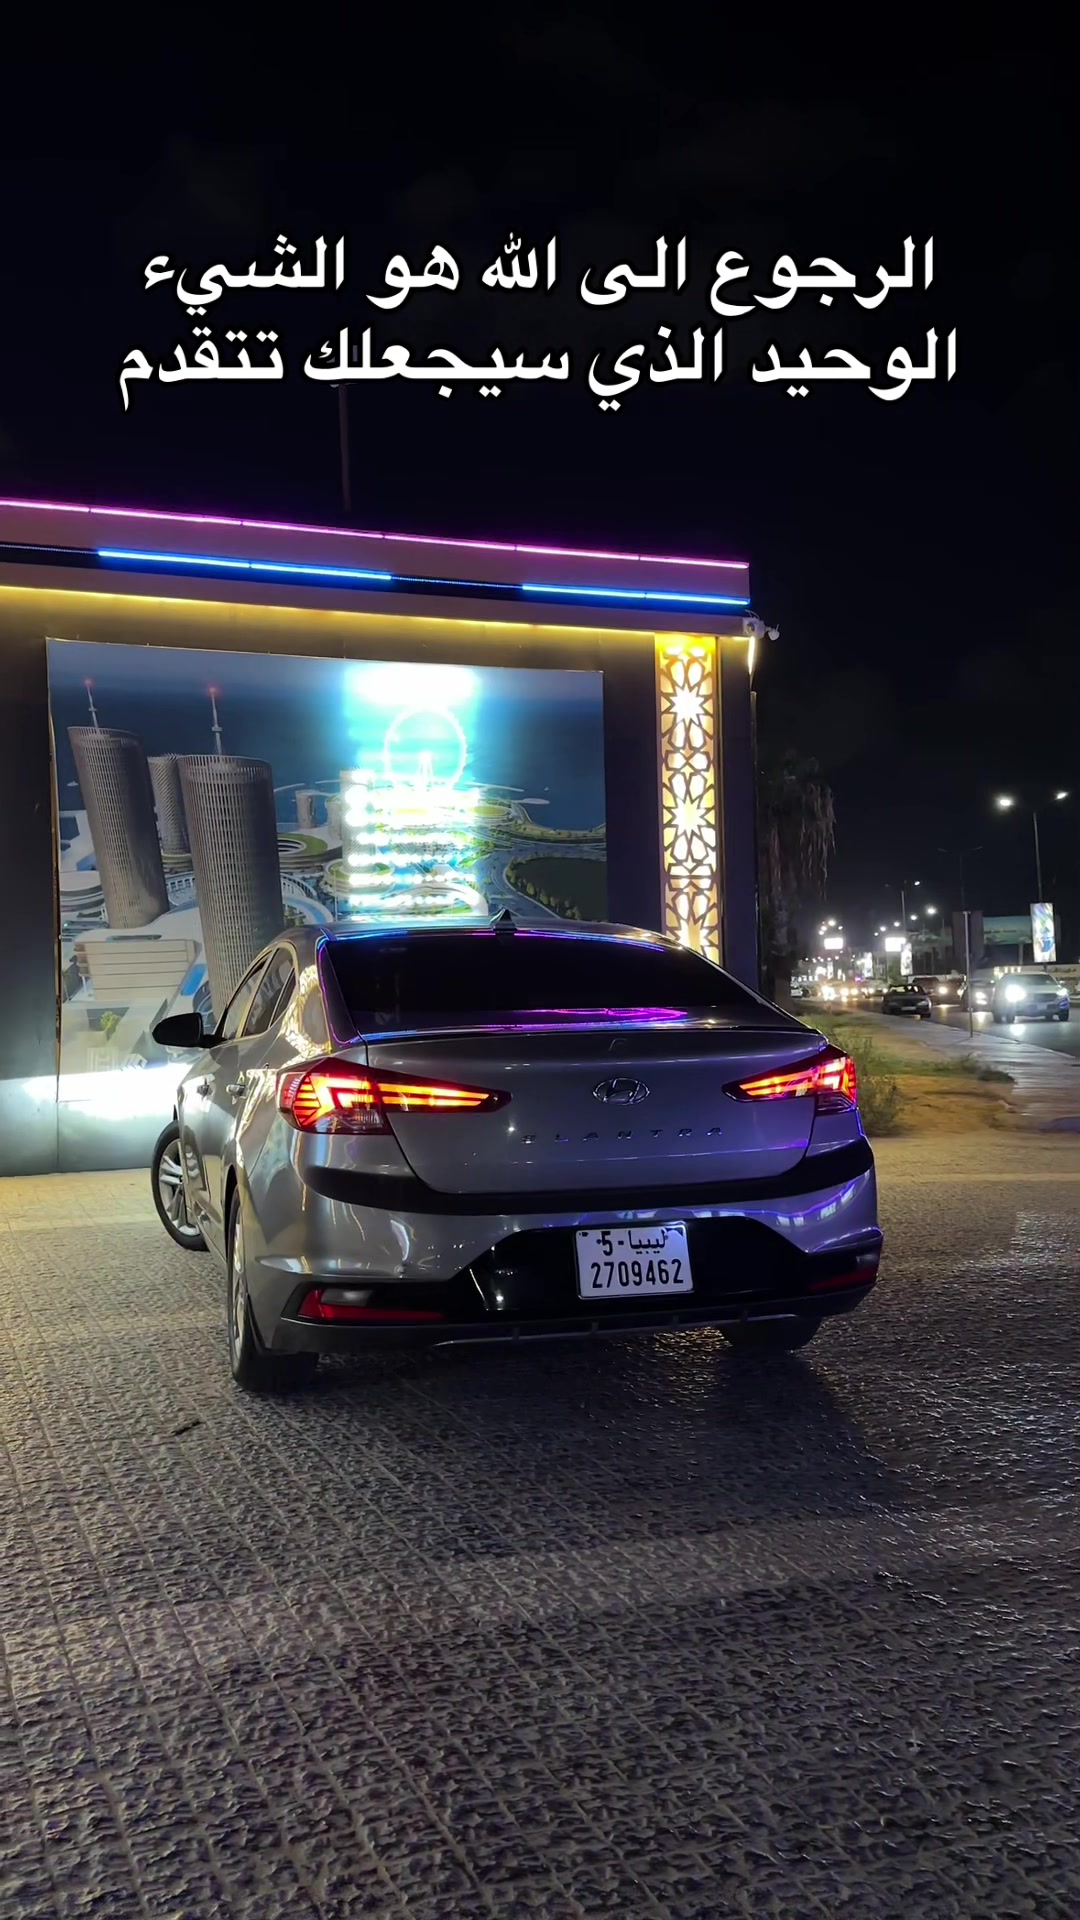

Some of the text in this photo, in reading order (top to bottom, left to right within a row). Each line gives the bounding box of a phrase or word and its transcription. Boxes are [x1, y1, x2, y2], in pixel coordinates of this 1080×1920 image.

[521, 1127, 723, 1144] ELANTRA
[628, 1230, 667, 1254] ليبيا
[590, 1259, 684, 1289] 2709462
